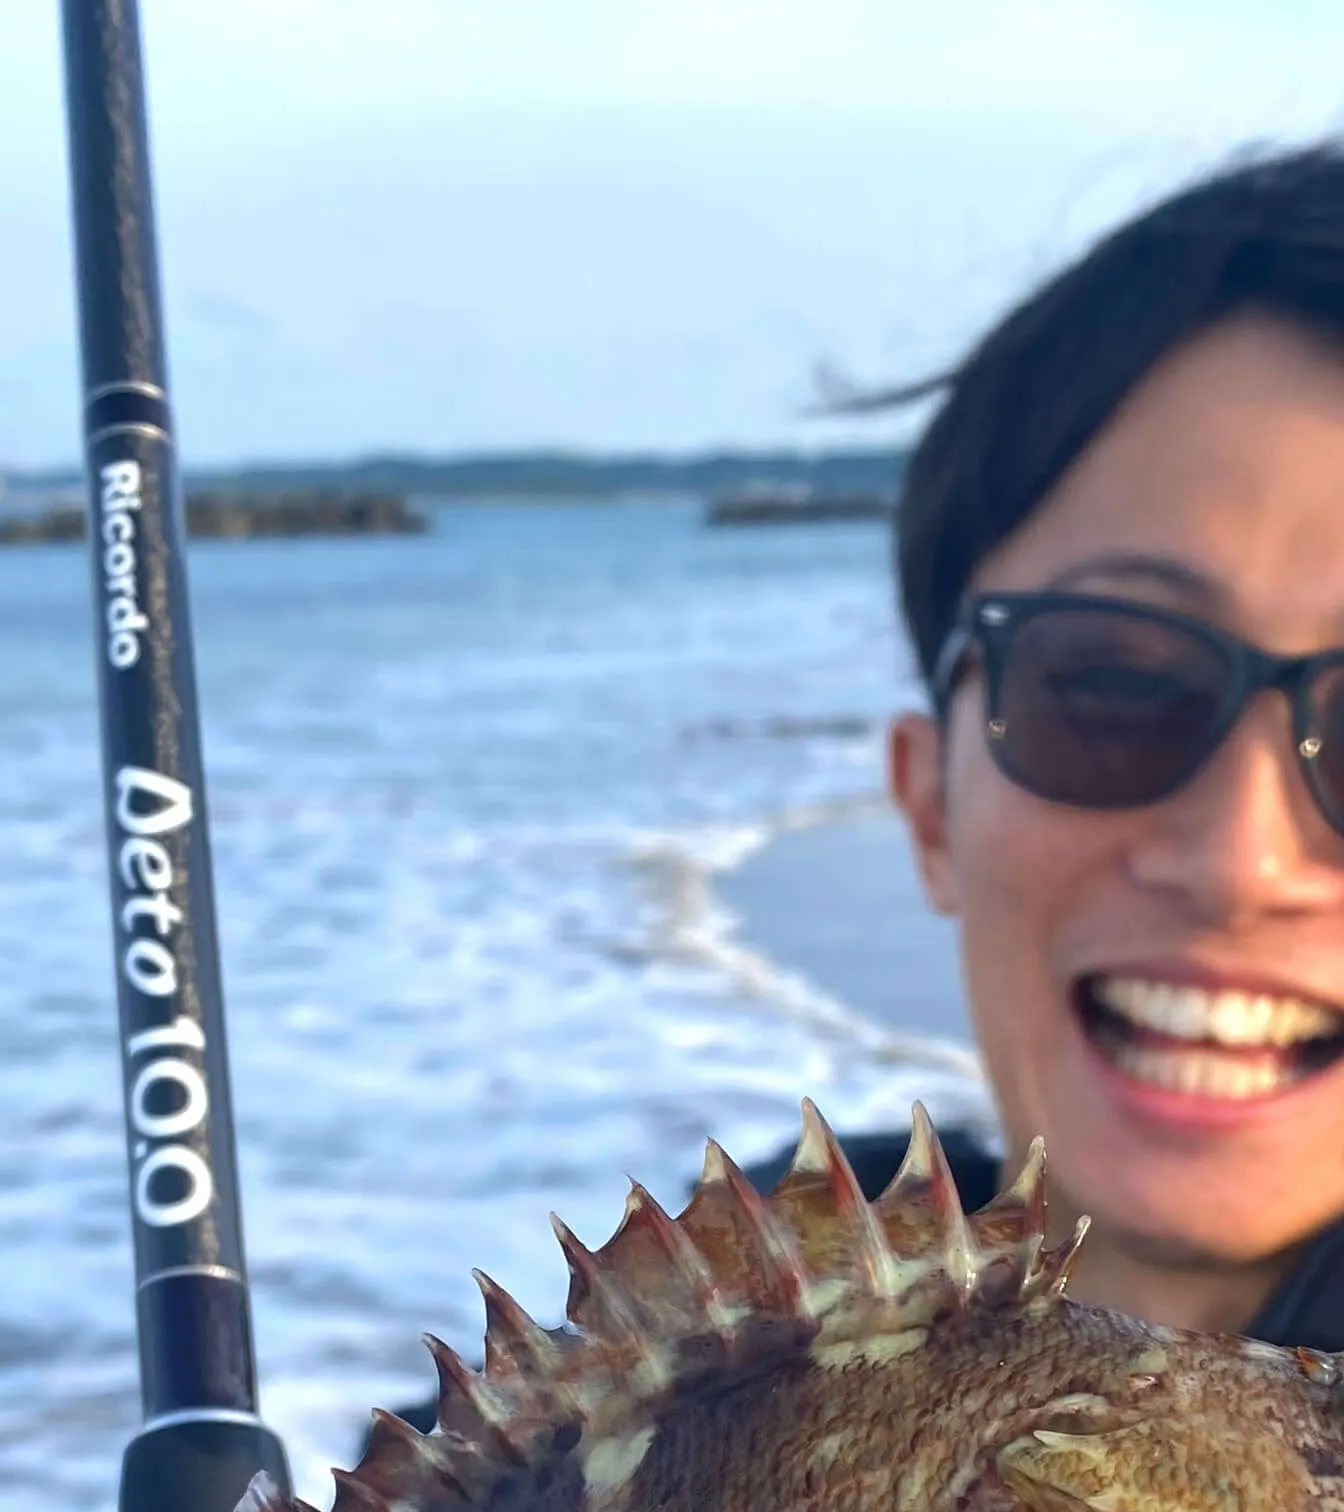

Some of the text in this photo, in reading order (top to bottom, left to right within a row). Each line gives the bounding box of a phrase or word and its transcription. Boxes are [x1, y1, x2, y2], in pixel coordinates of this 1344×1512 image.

[101, 459, 149, 671] Ricordo
[115, 766, 212, 1228] Deto 10.0
